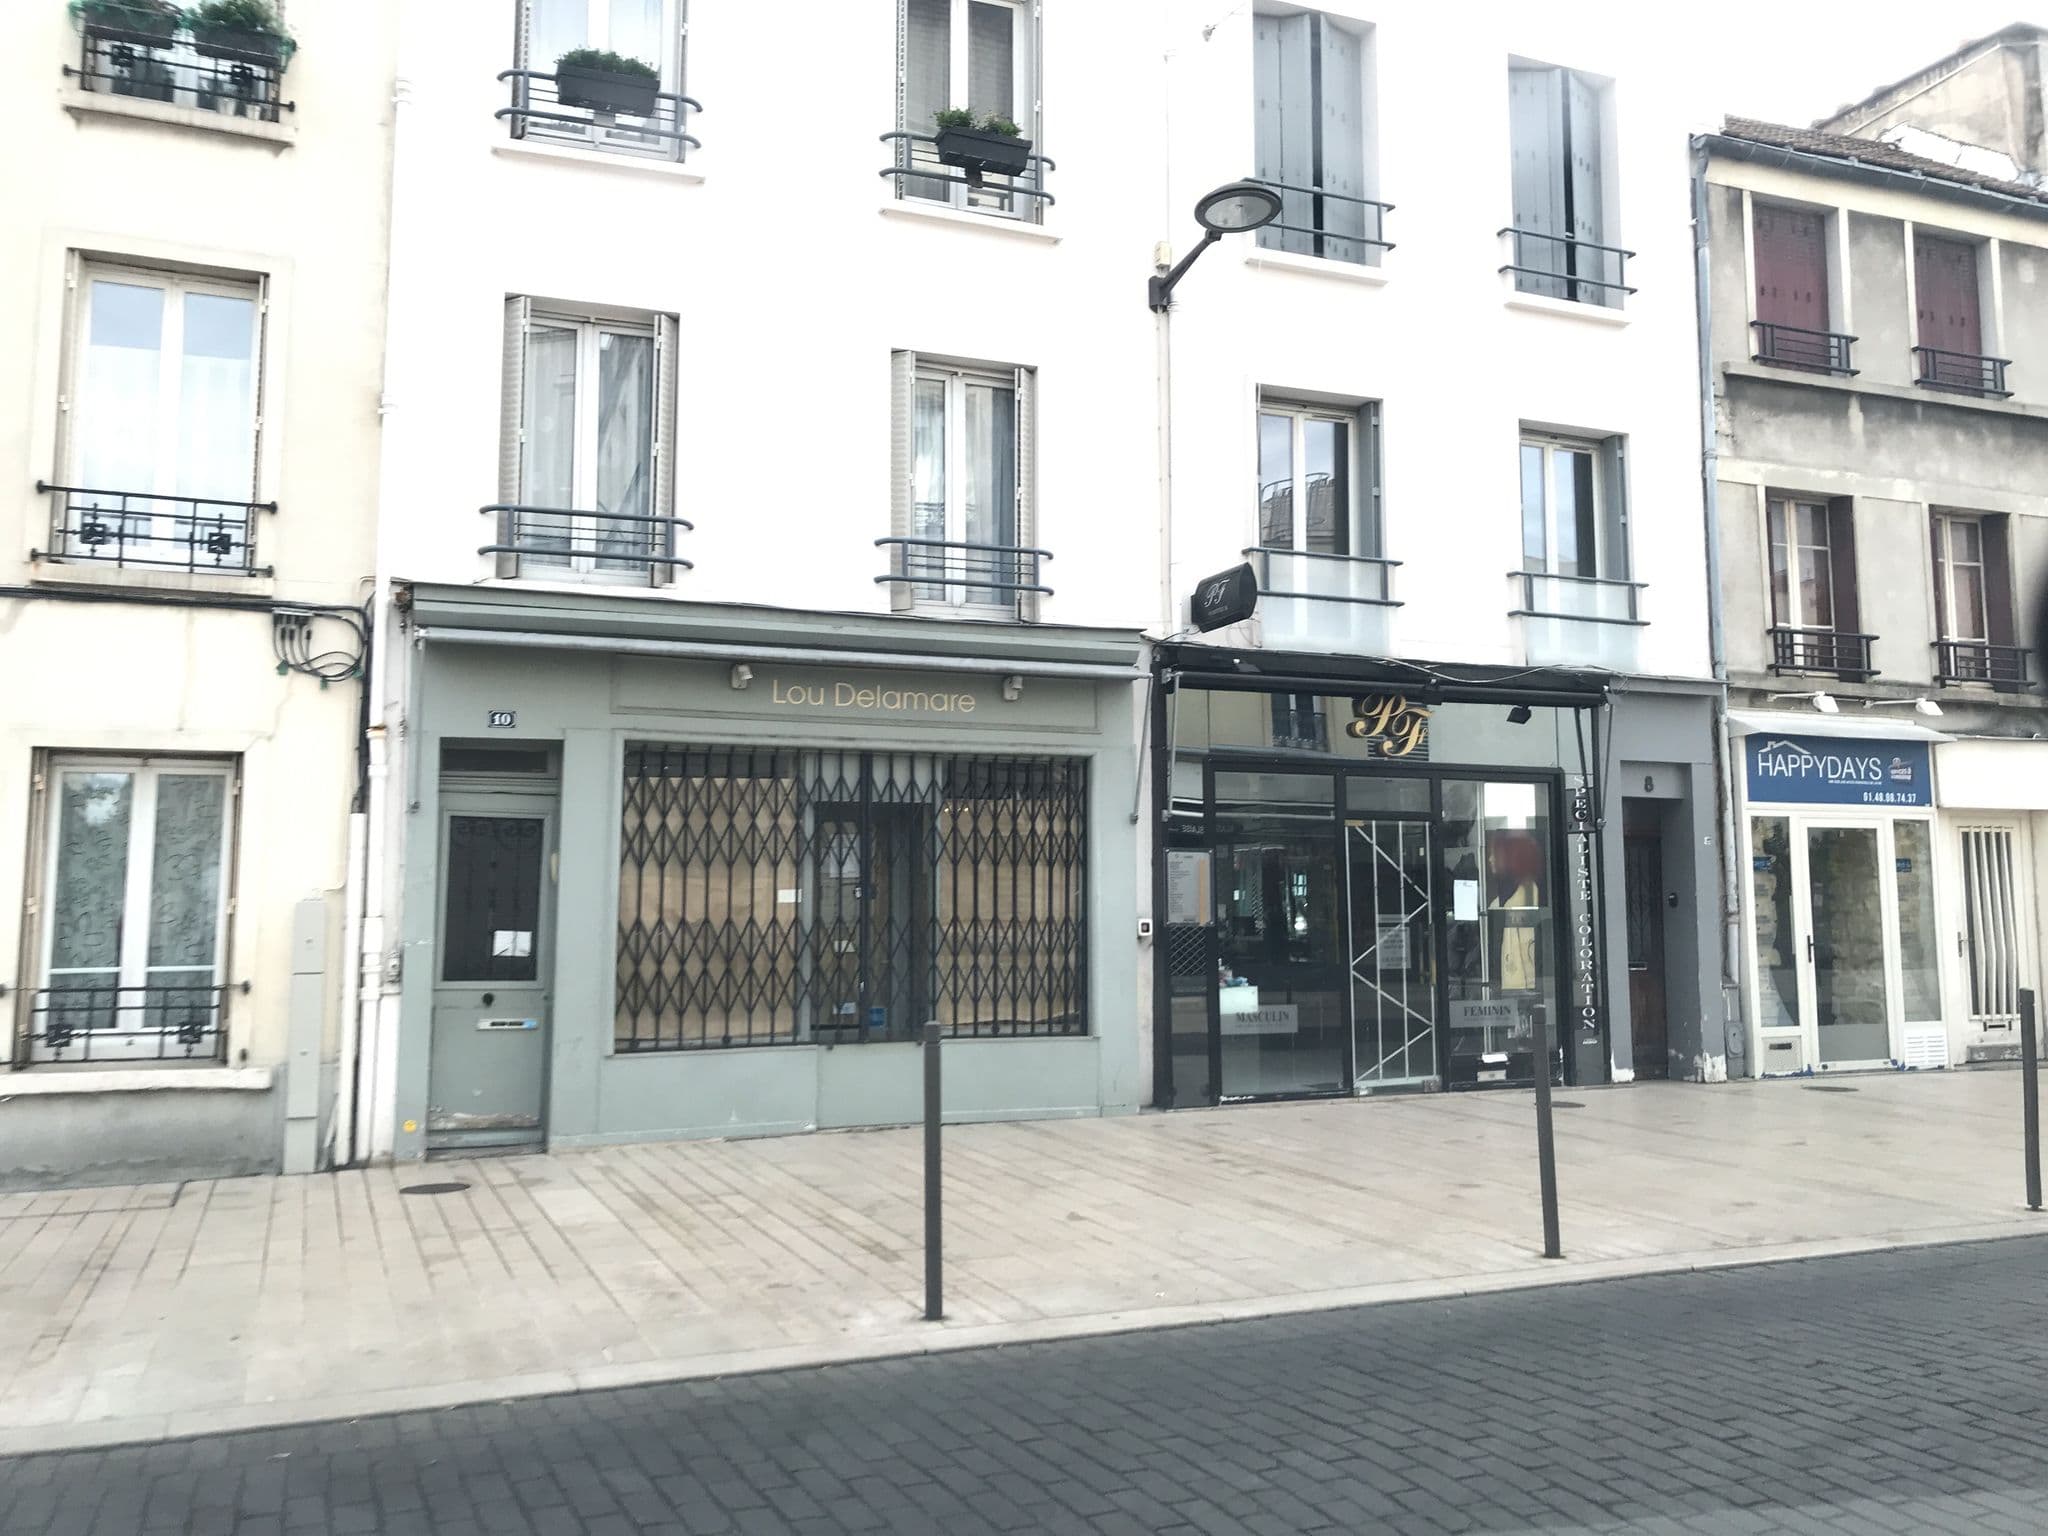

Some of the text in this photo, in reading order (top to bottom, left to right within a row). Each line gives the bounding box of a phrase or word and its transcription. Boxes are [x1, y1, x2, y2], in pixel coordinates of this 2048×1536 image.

[772, 679, 976, 713] Lou Delamare
[493, 713, 512, 726] 10
[1758, 753, 1882, 780] HAPPYDAYS
[1643, 775, 1655, 793] 8
[1574, 775, 1592, 901] SPECIALISTE
[1578, 913, 1597, 1030] COLORATION
